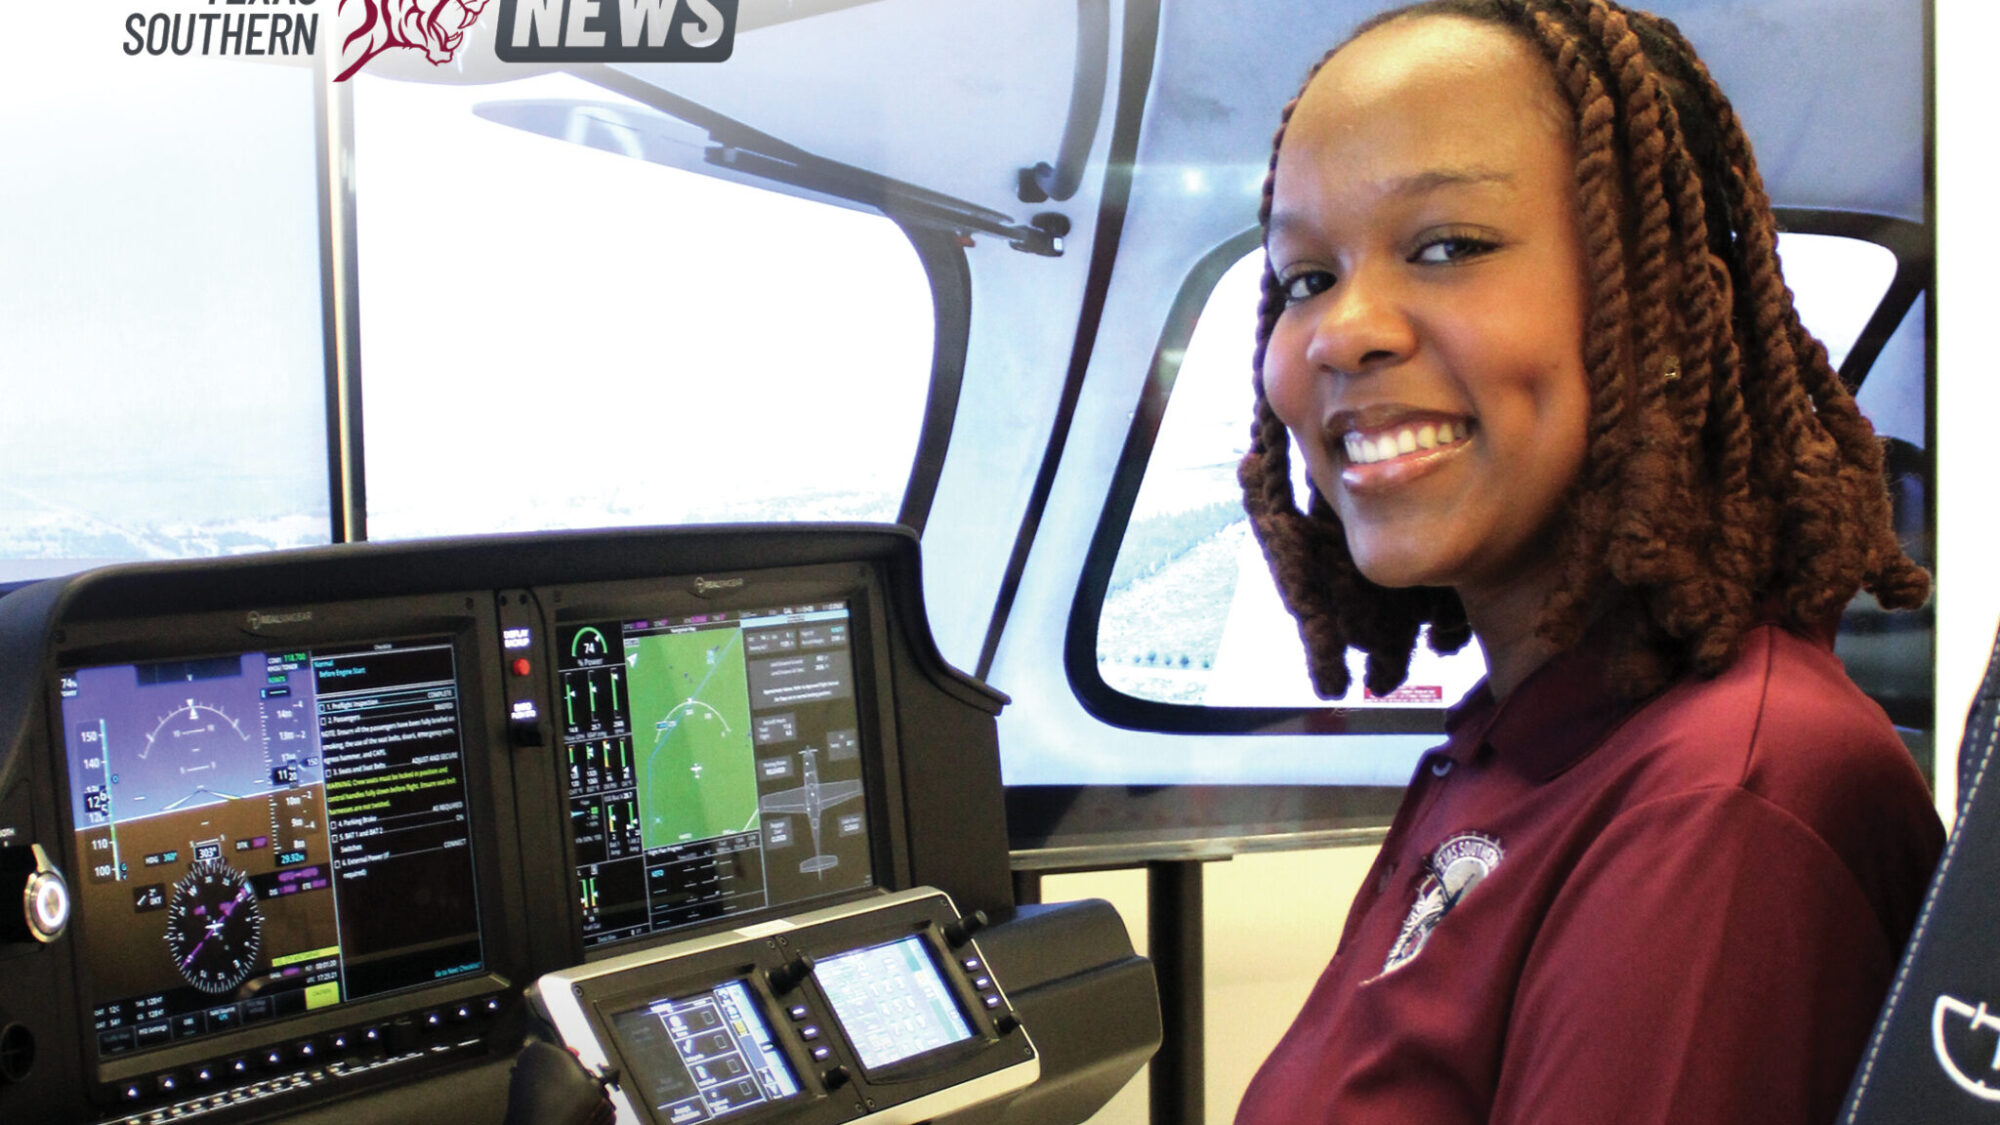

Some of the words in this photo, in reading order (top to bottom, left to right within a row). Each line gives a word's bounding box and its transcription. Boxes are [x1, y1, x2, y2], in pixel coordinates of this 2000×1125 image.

[583, 643, 595, 654] 74
[314, 659, 334, 667] Normal
[319, 669, 335, 679] Before
[335, 667, 352, 678] Engine
[81, 731, 98, 742] 150
[84, 758, 100, 769] 140
[92, 838, 108, 850] 110
[94, 865, 112, 876] 100
